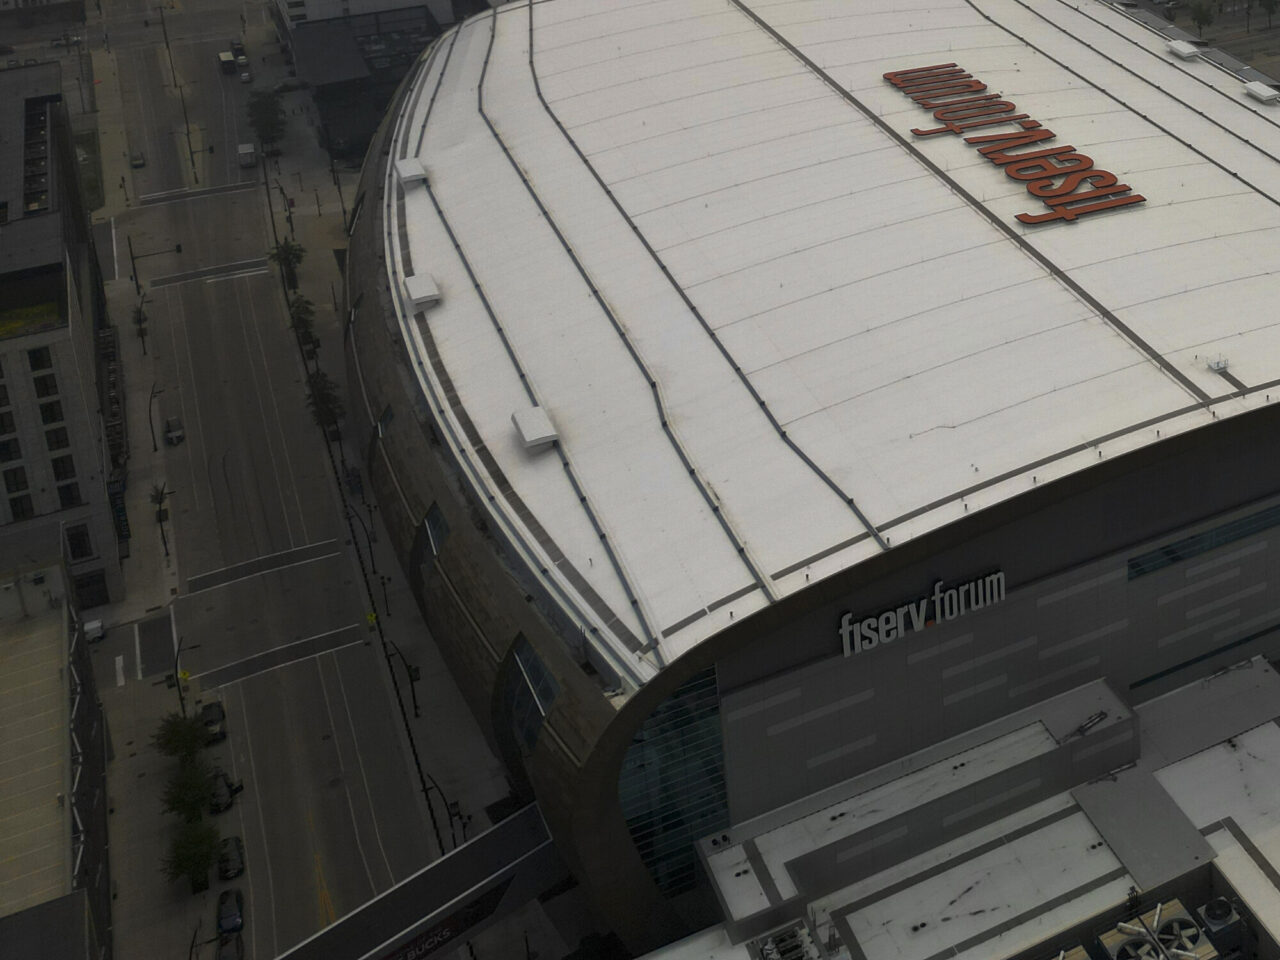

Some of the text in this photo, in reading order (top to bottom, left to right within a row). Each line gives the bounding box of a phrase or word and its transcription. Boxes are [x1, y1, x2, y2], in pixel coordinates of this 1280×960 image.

[883, 63, 1030, 136] forum
[931, 571, 1006, 624] forum
[406, 927, 451, 960] BUCKS
